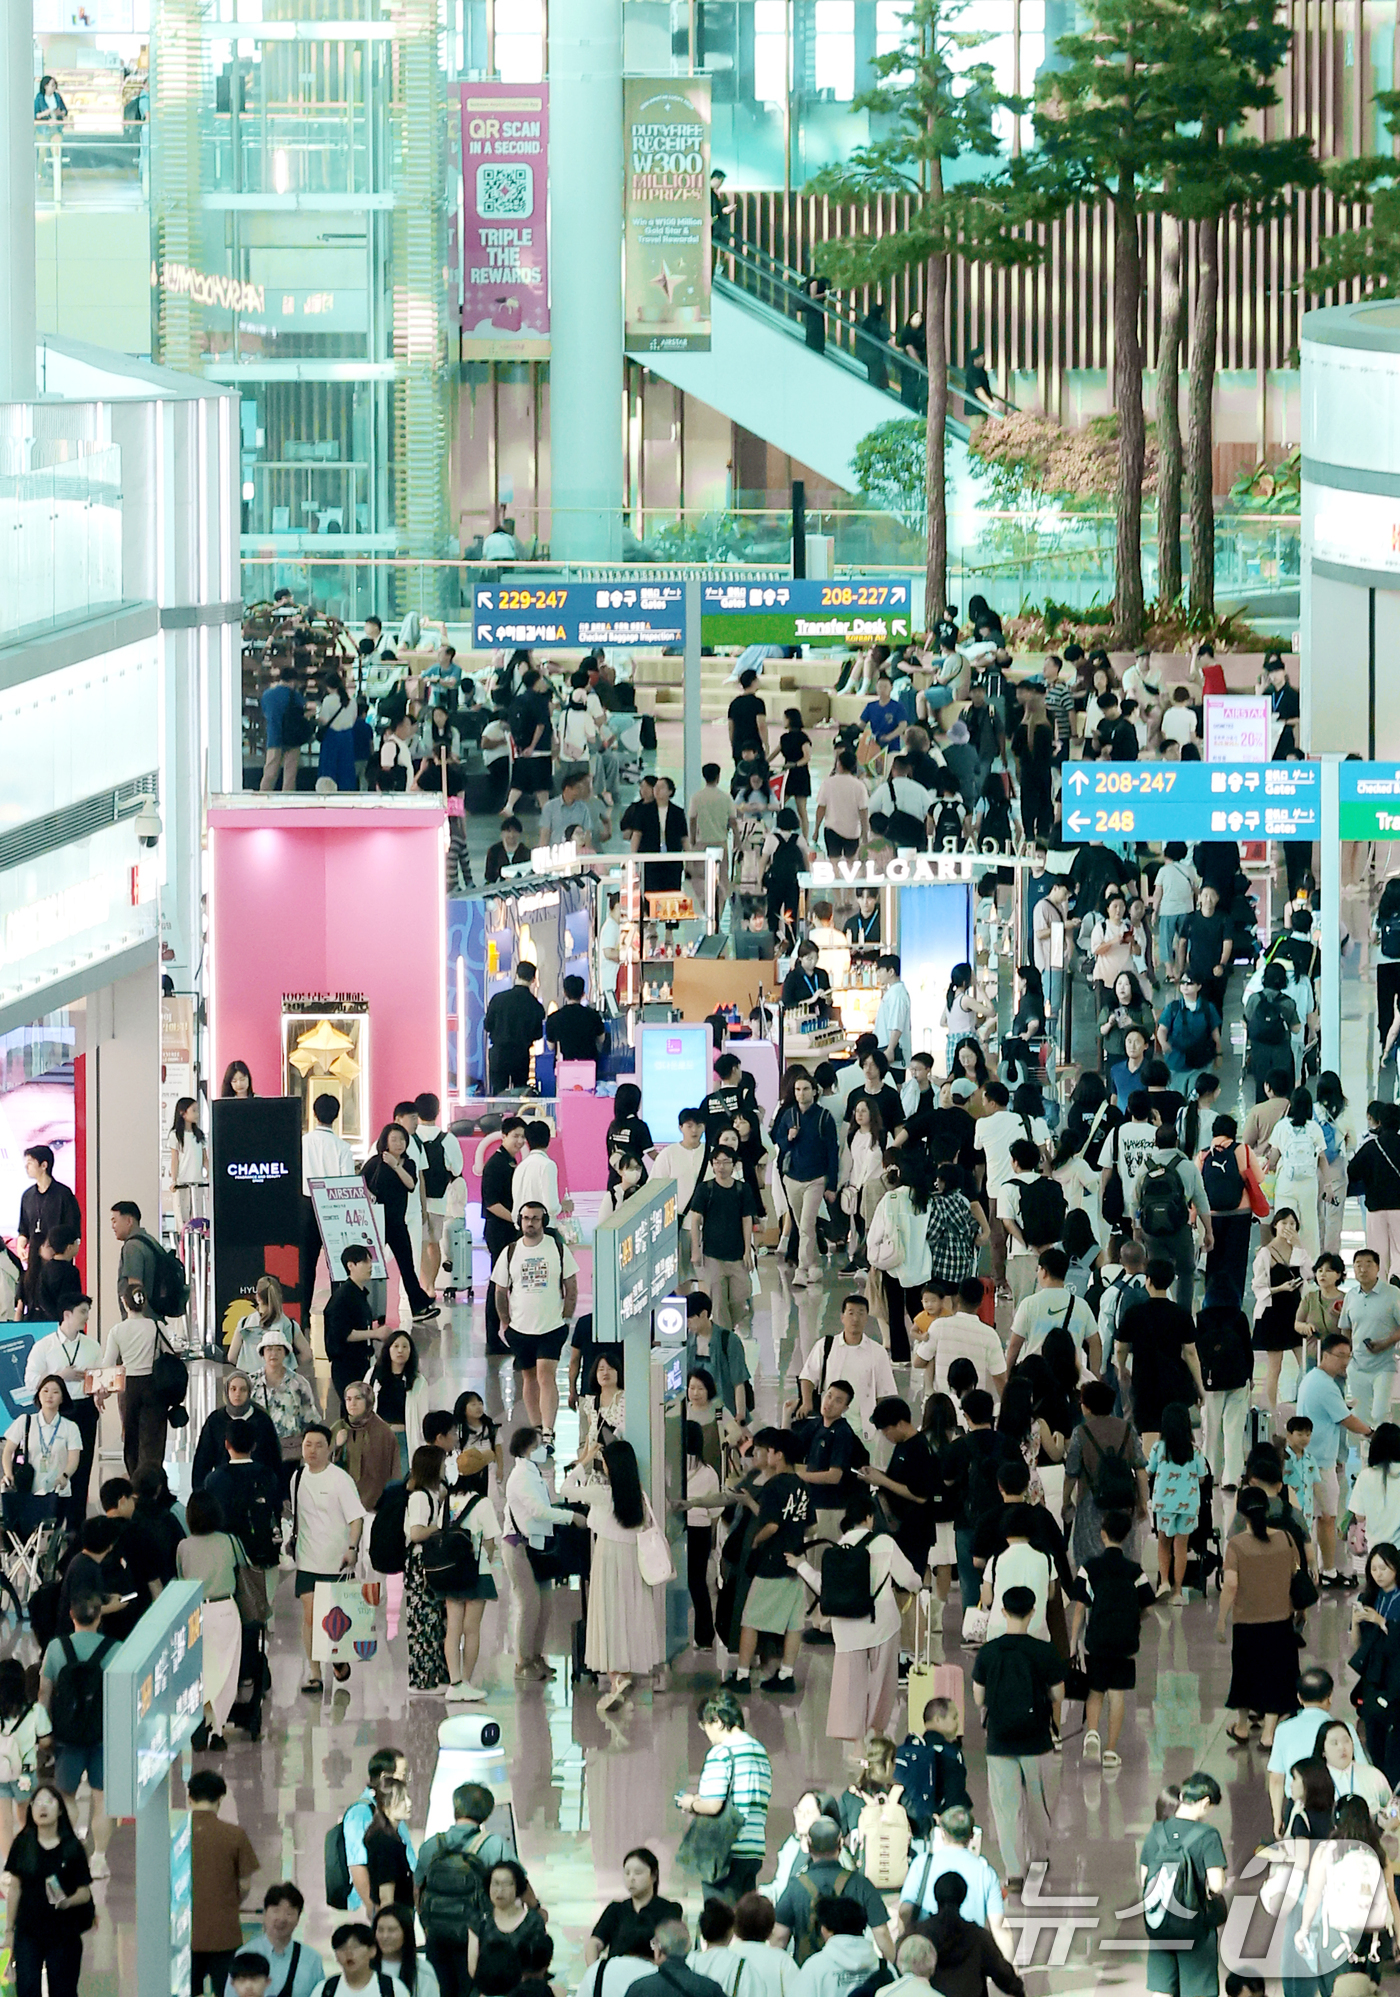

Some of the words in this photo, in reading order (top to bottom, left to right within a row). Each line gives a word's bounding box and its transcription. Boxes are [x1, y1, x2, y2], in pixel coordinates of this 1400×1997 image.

[469, 118, 500, 139] QR
[502, 121, 540, 137] SCAN
[469, 141, 481, 154] IN
[484, 142, 492, 154] A
[632, 136, 703, 153] RECEIPT
[633, 173, 704, 188] MILLION
[478, 227, 532, 246] TRIPLE
[486, 246, 521, 266] THE
[470, 267, 542, 284] REWARDS
[498, 590, 568, 610] 229-247
[821, 587, 888, 606] 208-227
[795, 618, 850, 635] Transfer
[853, 618, 887, 635] Desk
[1095, 771, 1177, 793] 208-247
[1211, 771, 1260, 793] 탑승구
[1265, 784, 1296, 795] Gates
[1095, 810, 1135, 832] 248
[1211, 810, 1260, 832] 탑승구
[1265, 823, 1296, 834] Gates
[812, 857, 972, 885] BVLGARI
[227, 1162, 289, 1176] CHANEL
[329, 1187, 366, 1199] AIRSTAR
